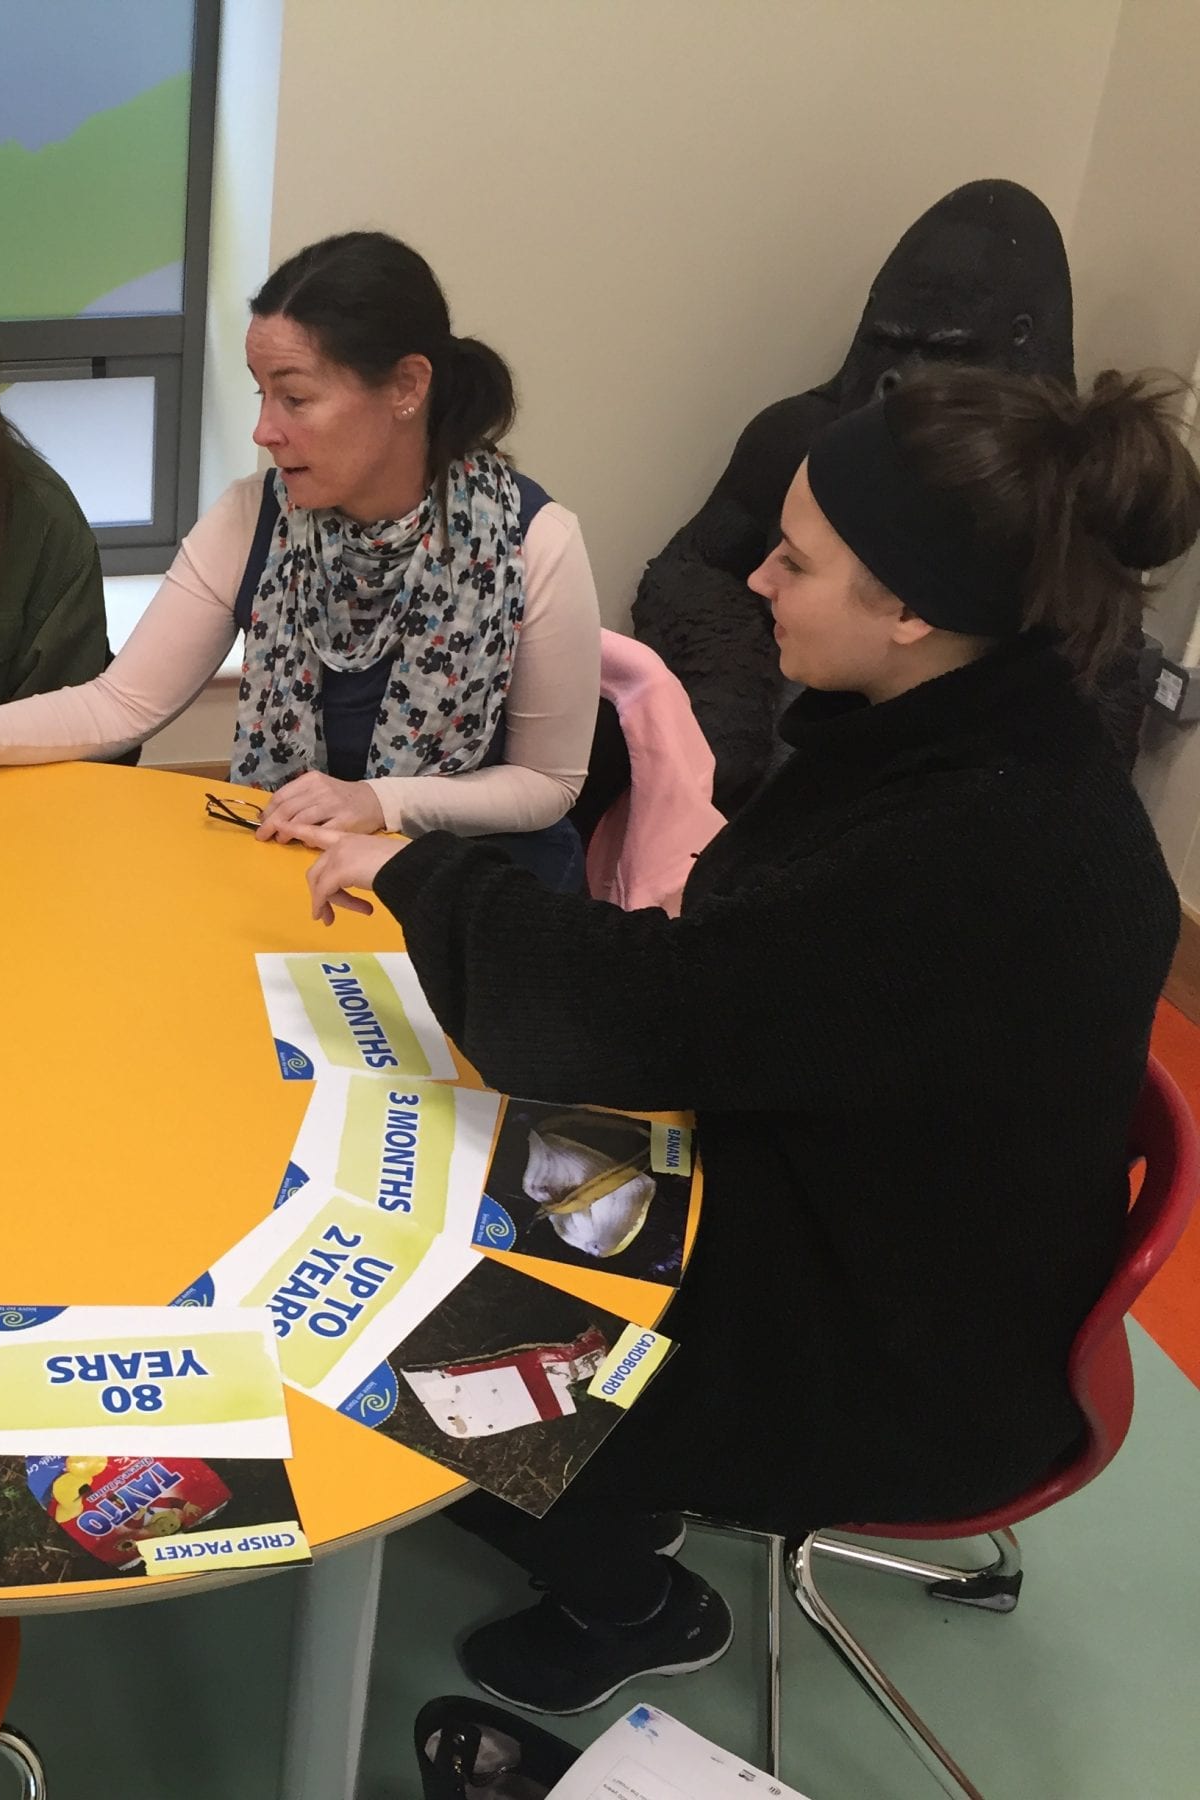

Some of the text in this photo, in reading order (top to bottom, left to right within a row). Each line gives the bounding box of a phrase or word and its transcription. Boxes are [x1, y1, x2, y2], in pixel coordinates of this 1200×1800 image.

[321, 962, 398, 1069] 2 MONTHS
[377, 1091, 420, 1214] 3 MONTHS
[665, 1128, 681, 1168] BANANA
[323, 1224, 361, 1249] 2
[307, 1256, 395, 1338] UP TO
[45, 1349, 208, 1384] YEARS
[601, 1333, 655, 1397] CARDBOARD
[101, 1384, 163, 1414] 80
[76, 1462, 184, 1537] TAYTO
[155, 1532, 296, 1561] CRISP PACKET
